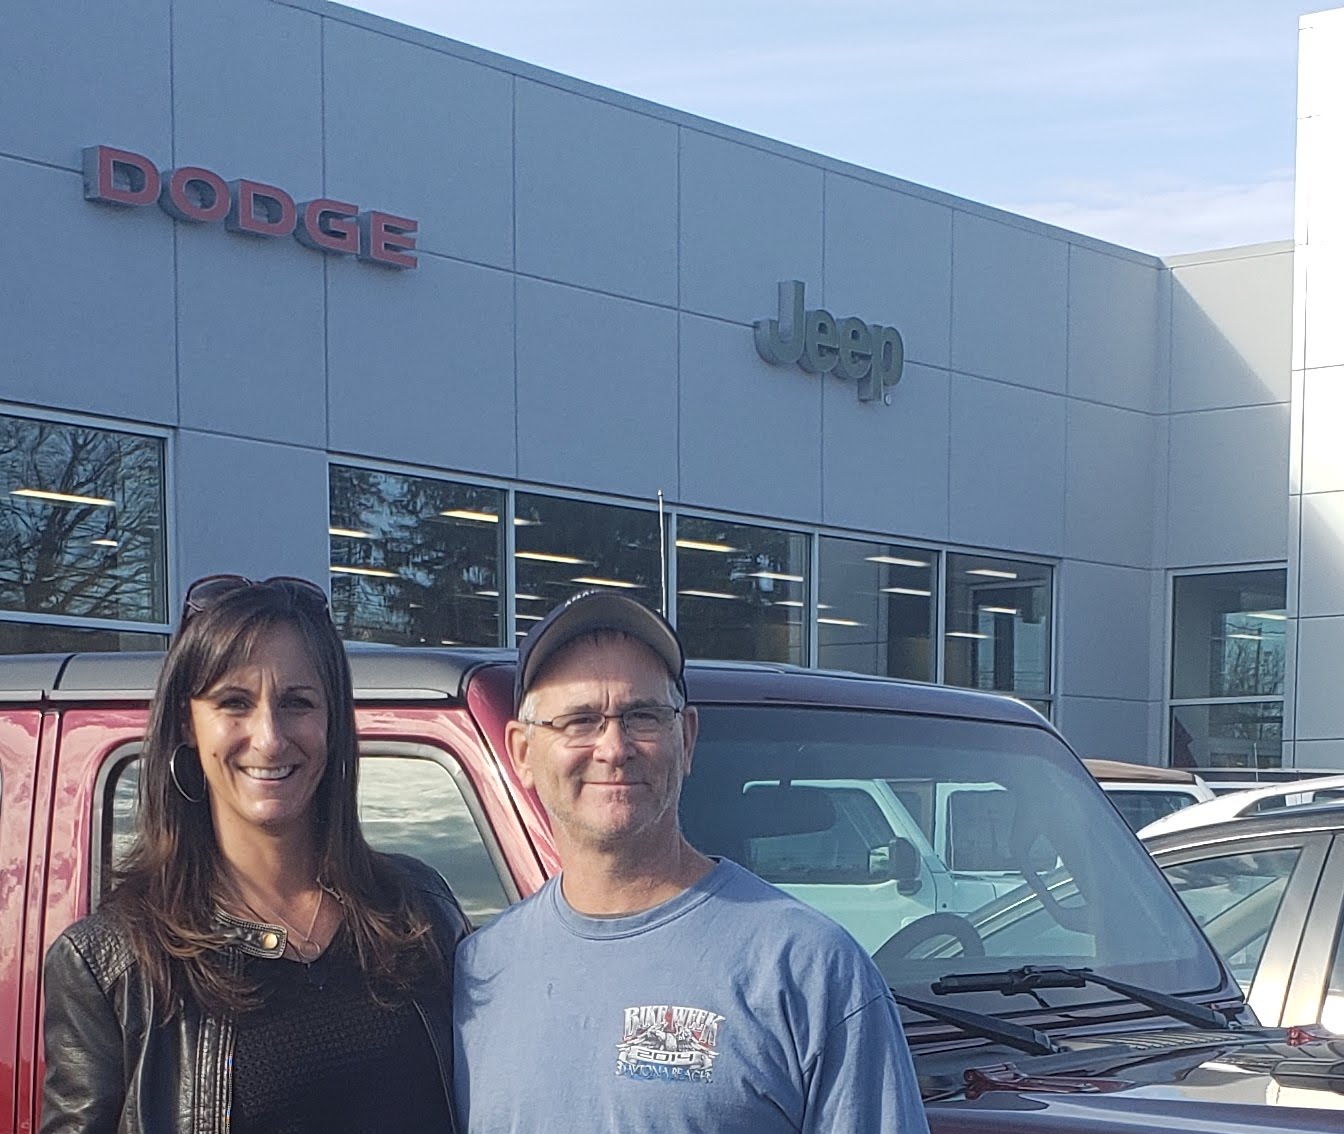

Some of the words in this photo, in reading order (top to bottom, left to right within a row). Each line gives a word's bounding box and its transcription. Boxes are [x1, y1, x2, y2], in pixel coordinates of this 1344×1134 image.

[84, 145, 419, 269] DODGE
[754, 280, 904, 402] Jeep
[623, 1005, 668, 1041] BIKE
[671, 1005, 726, 1046] WEEK
[616, 1060, 669, 1080] DAYTONA
[637, 1050, 694, 1063] 2014
